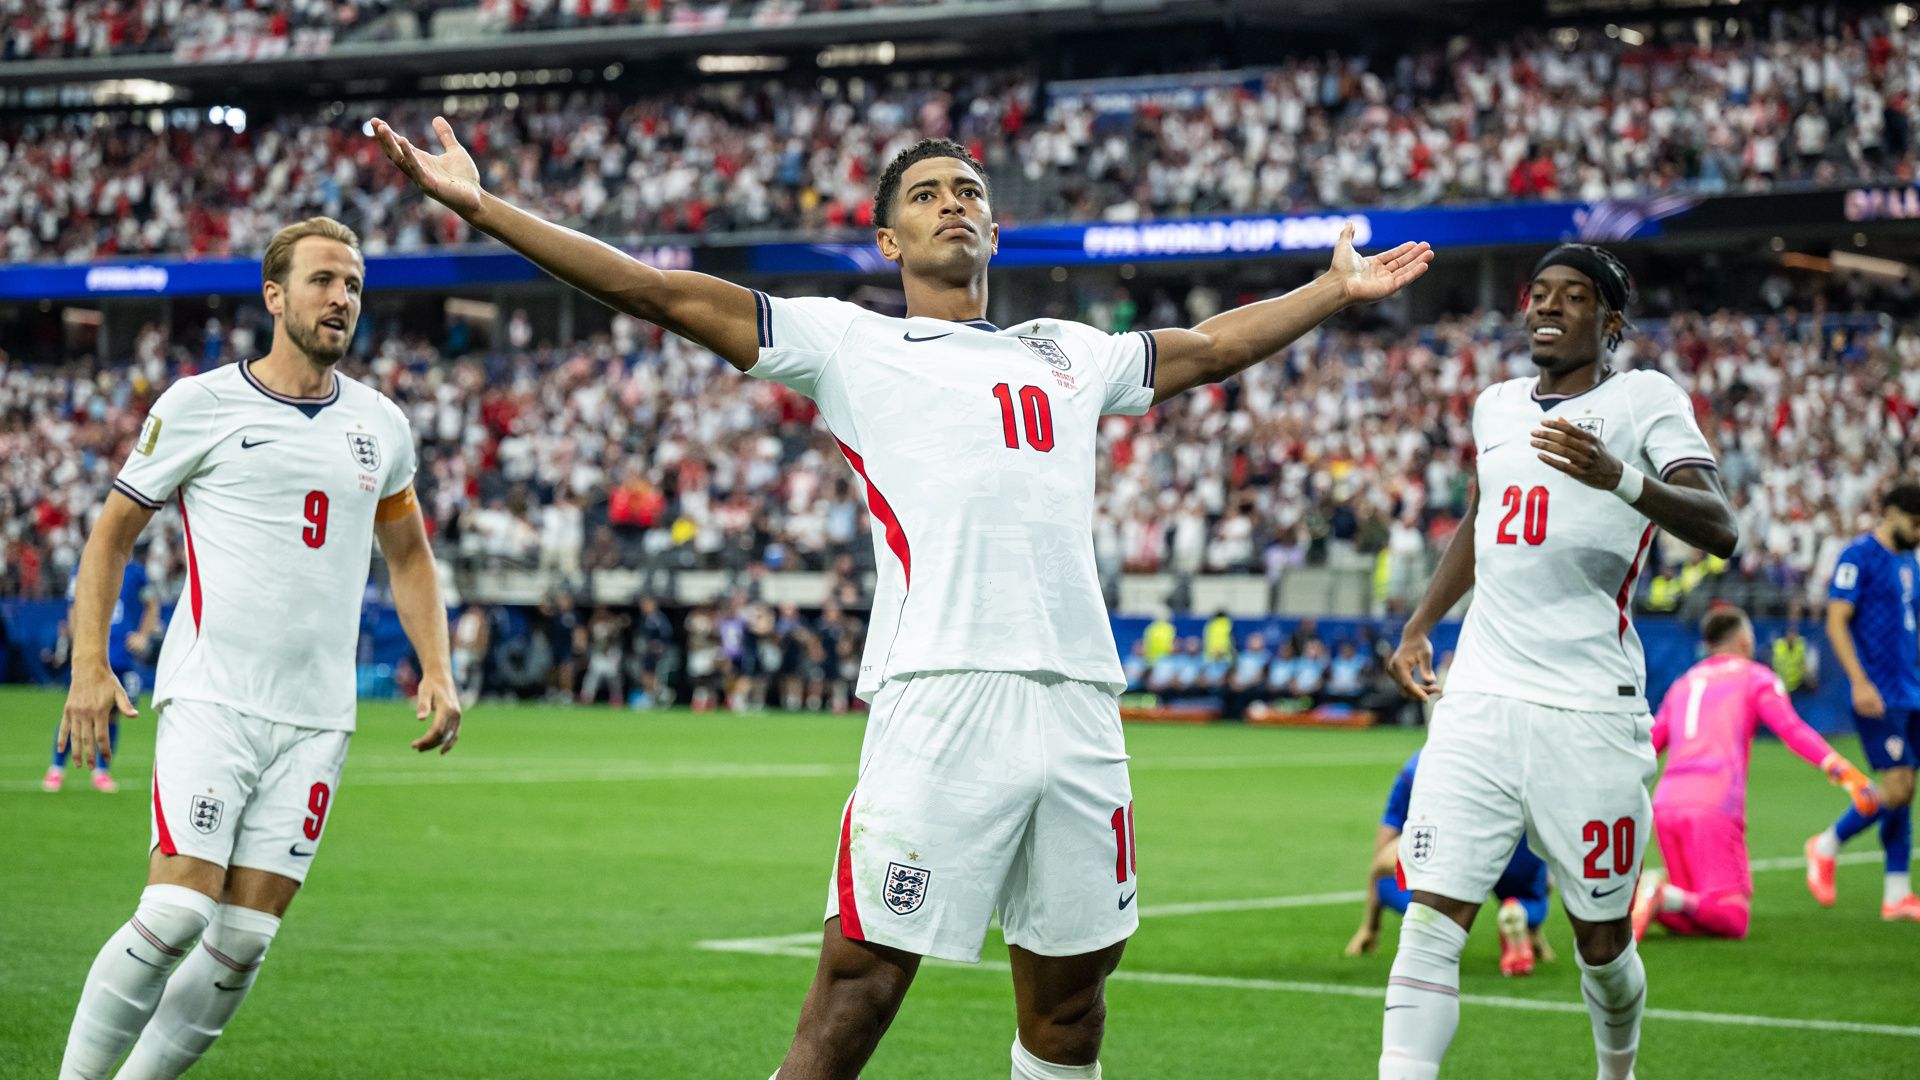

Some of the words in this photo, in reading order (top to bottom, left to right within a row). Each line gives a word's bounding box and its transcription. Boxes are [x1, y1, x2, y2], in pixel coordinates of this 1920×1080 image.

[1141, 222, 1228, 254] WORLD
[1230, 219, 1277, 251] CUP
[992, 383, 1055, 453] 10
[302, 490, 330, 549] 9
[1496, 485, 1550, 546] 20
[1684, 676, 1708, 740] 1
[303, 781, 330, 842] 9
[1582, 816, 1635, 879] 20
